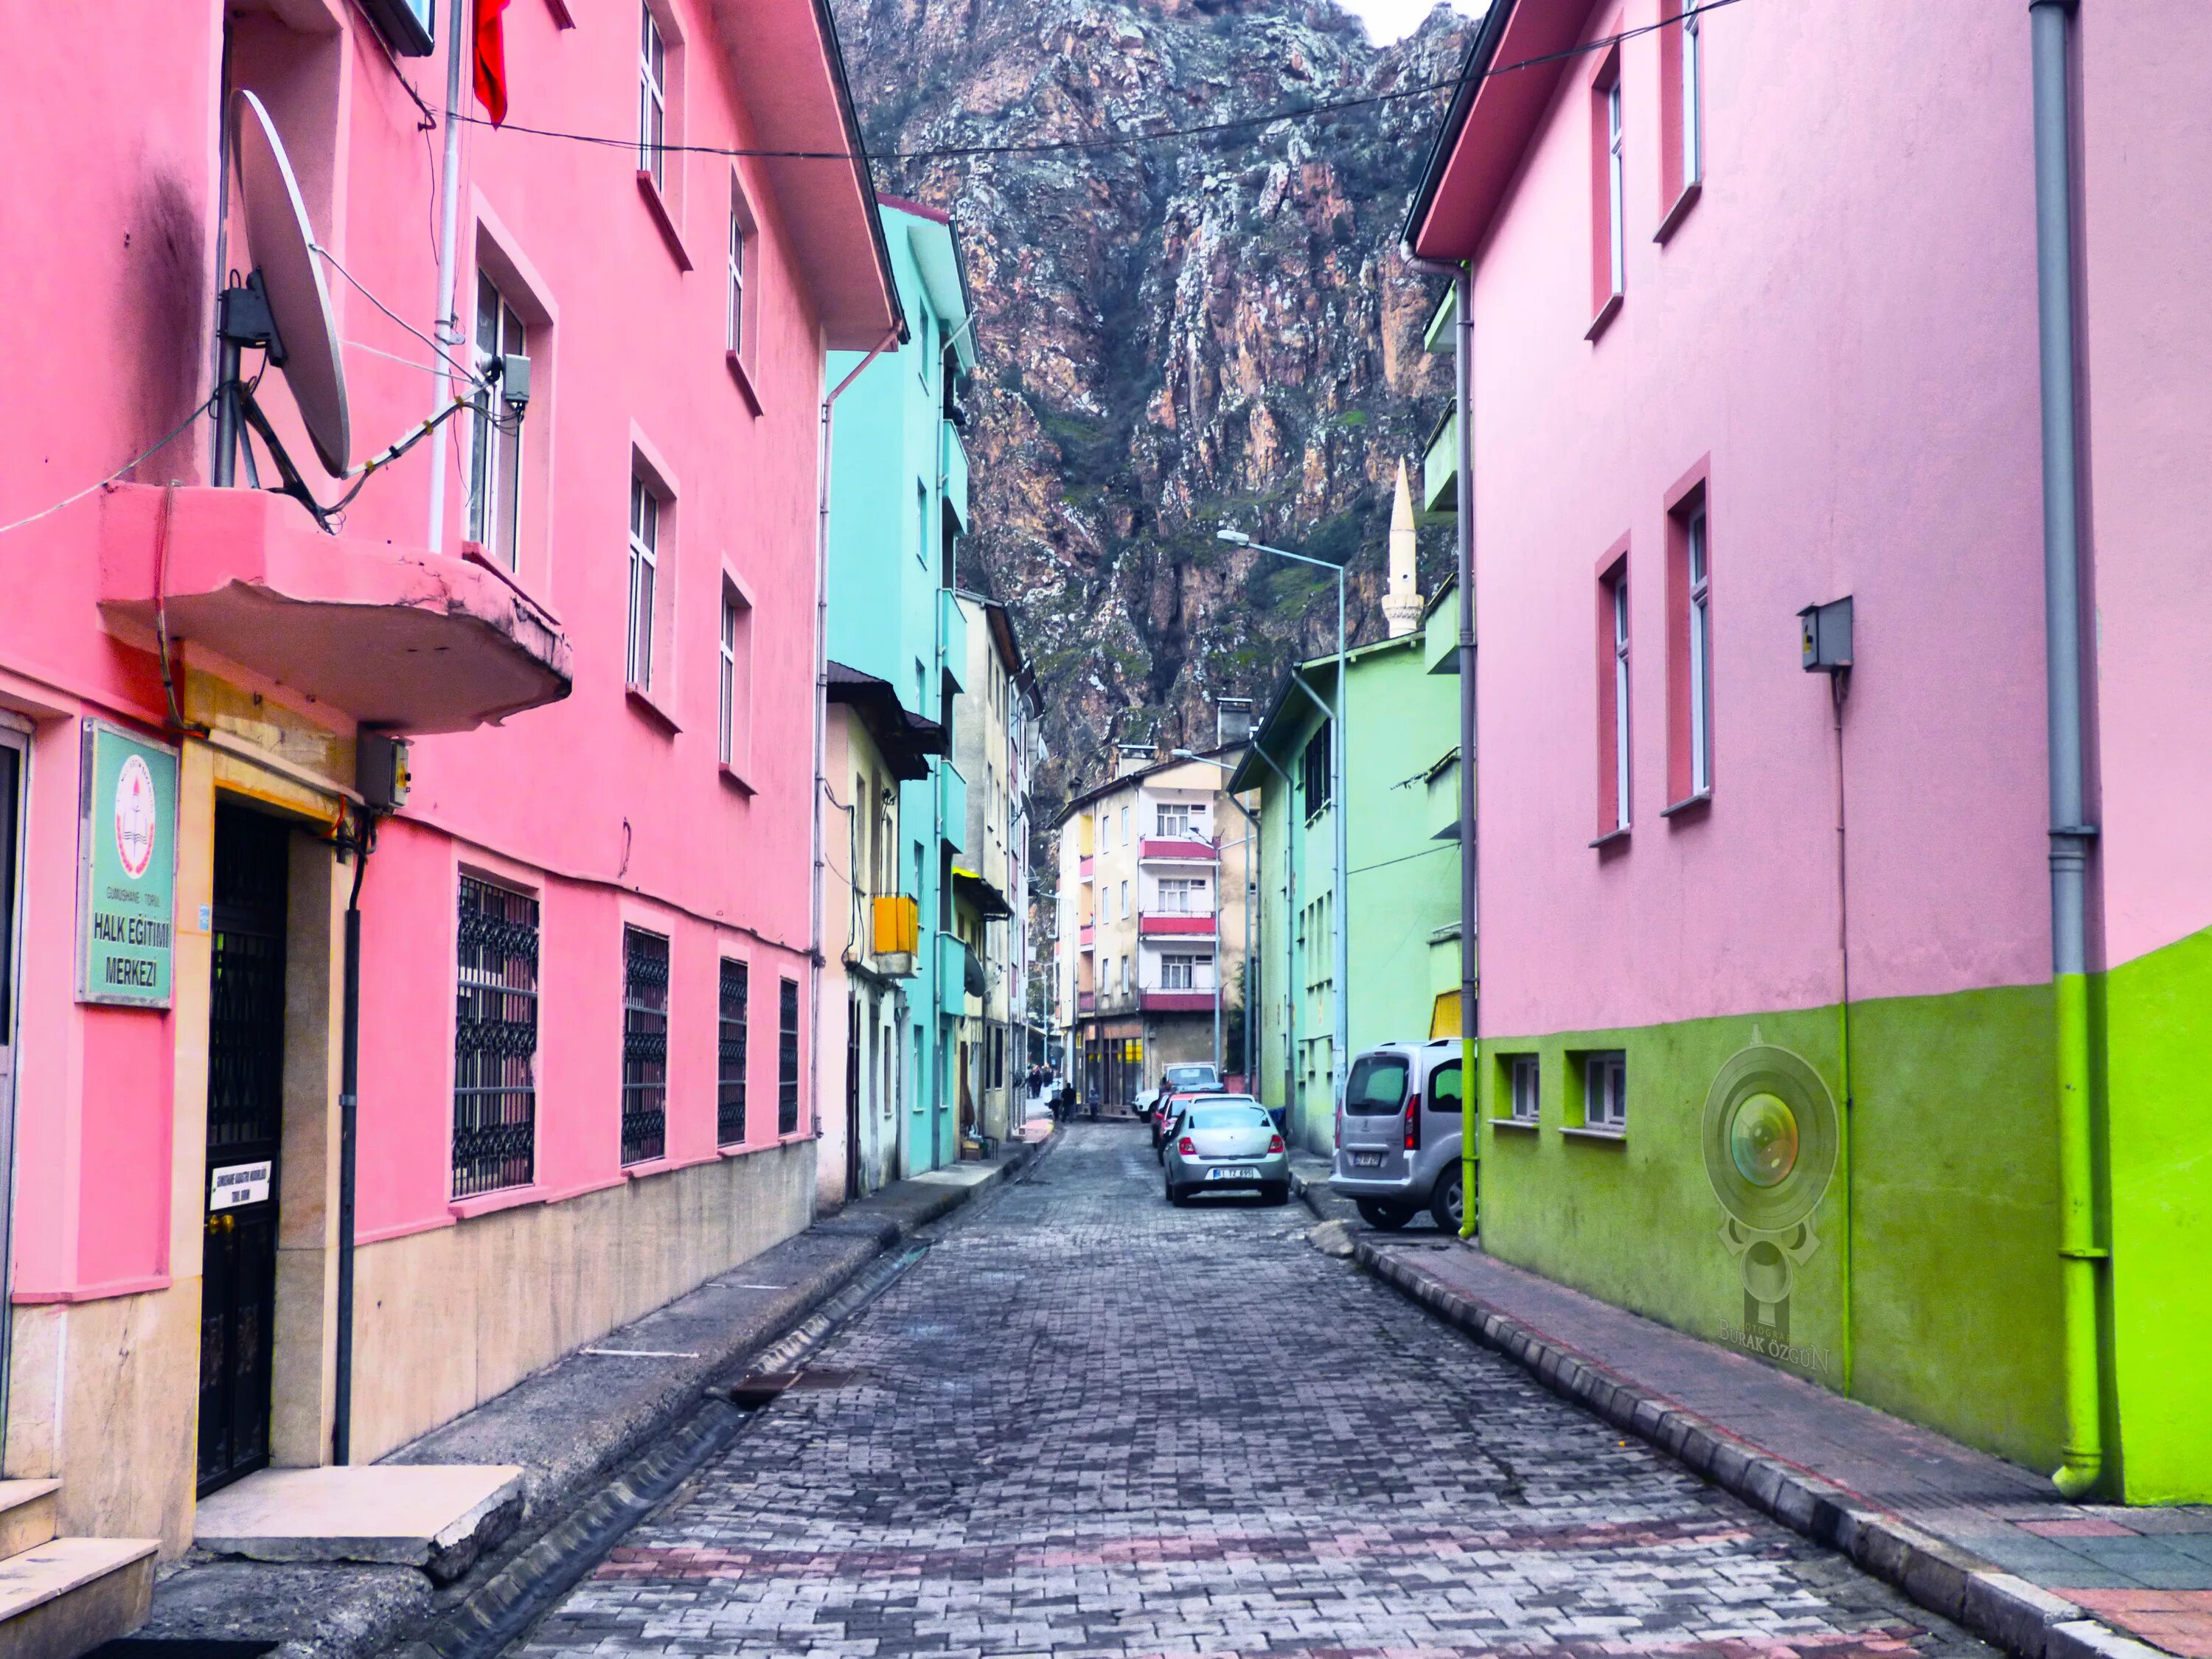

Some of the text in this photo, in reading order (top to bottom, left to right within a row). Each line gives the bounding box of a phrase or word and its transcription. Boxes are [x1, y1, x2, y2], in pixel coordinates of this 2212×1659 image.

[94, 912, 170, 948] HALK EĞİTİMİ
[105, 956, 157, 987] MERKEZİ
